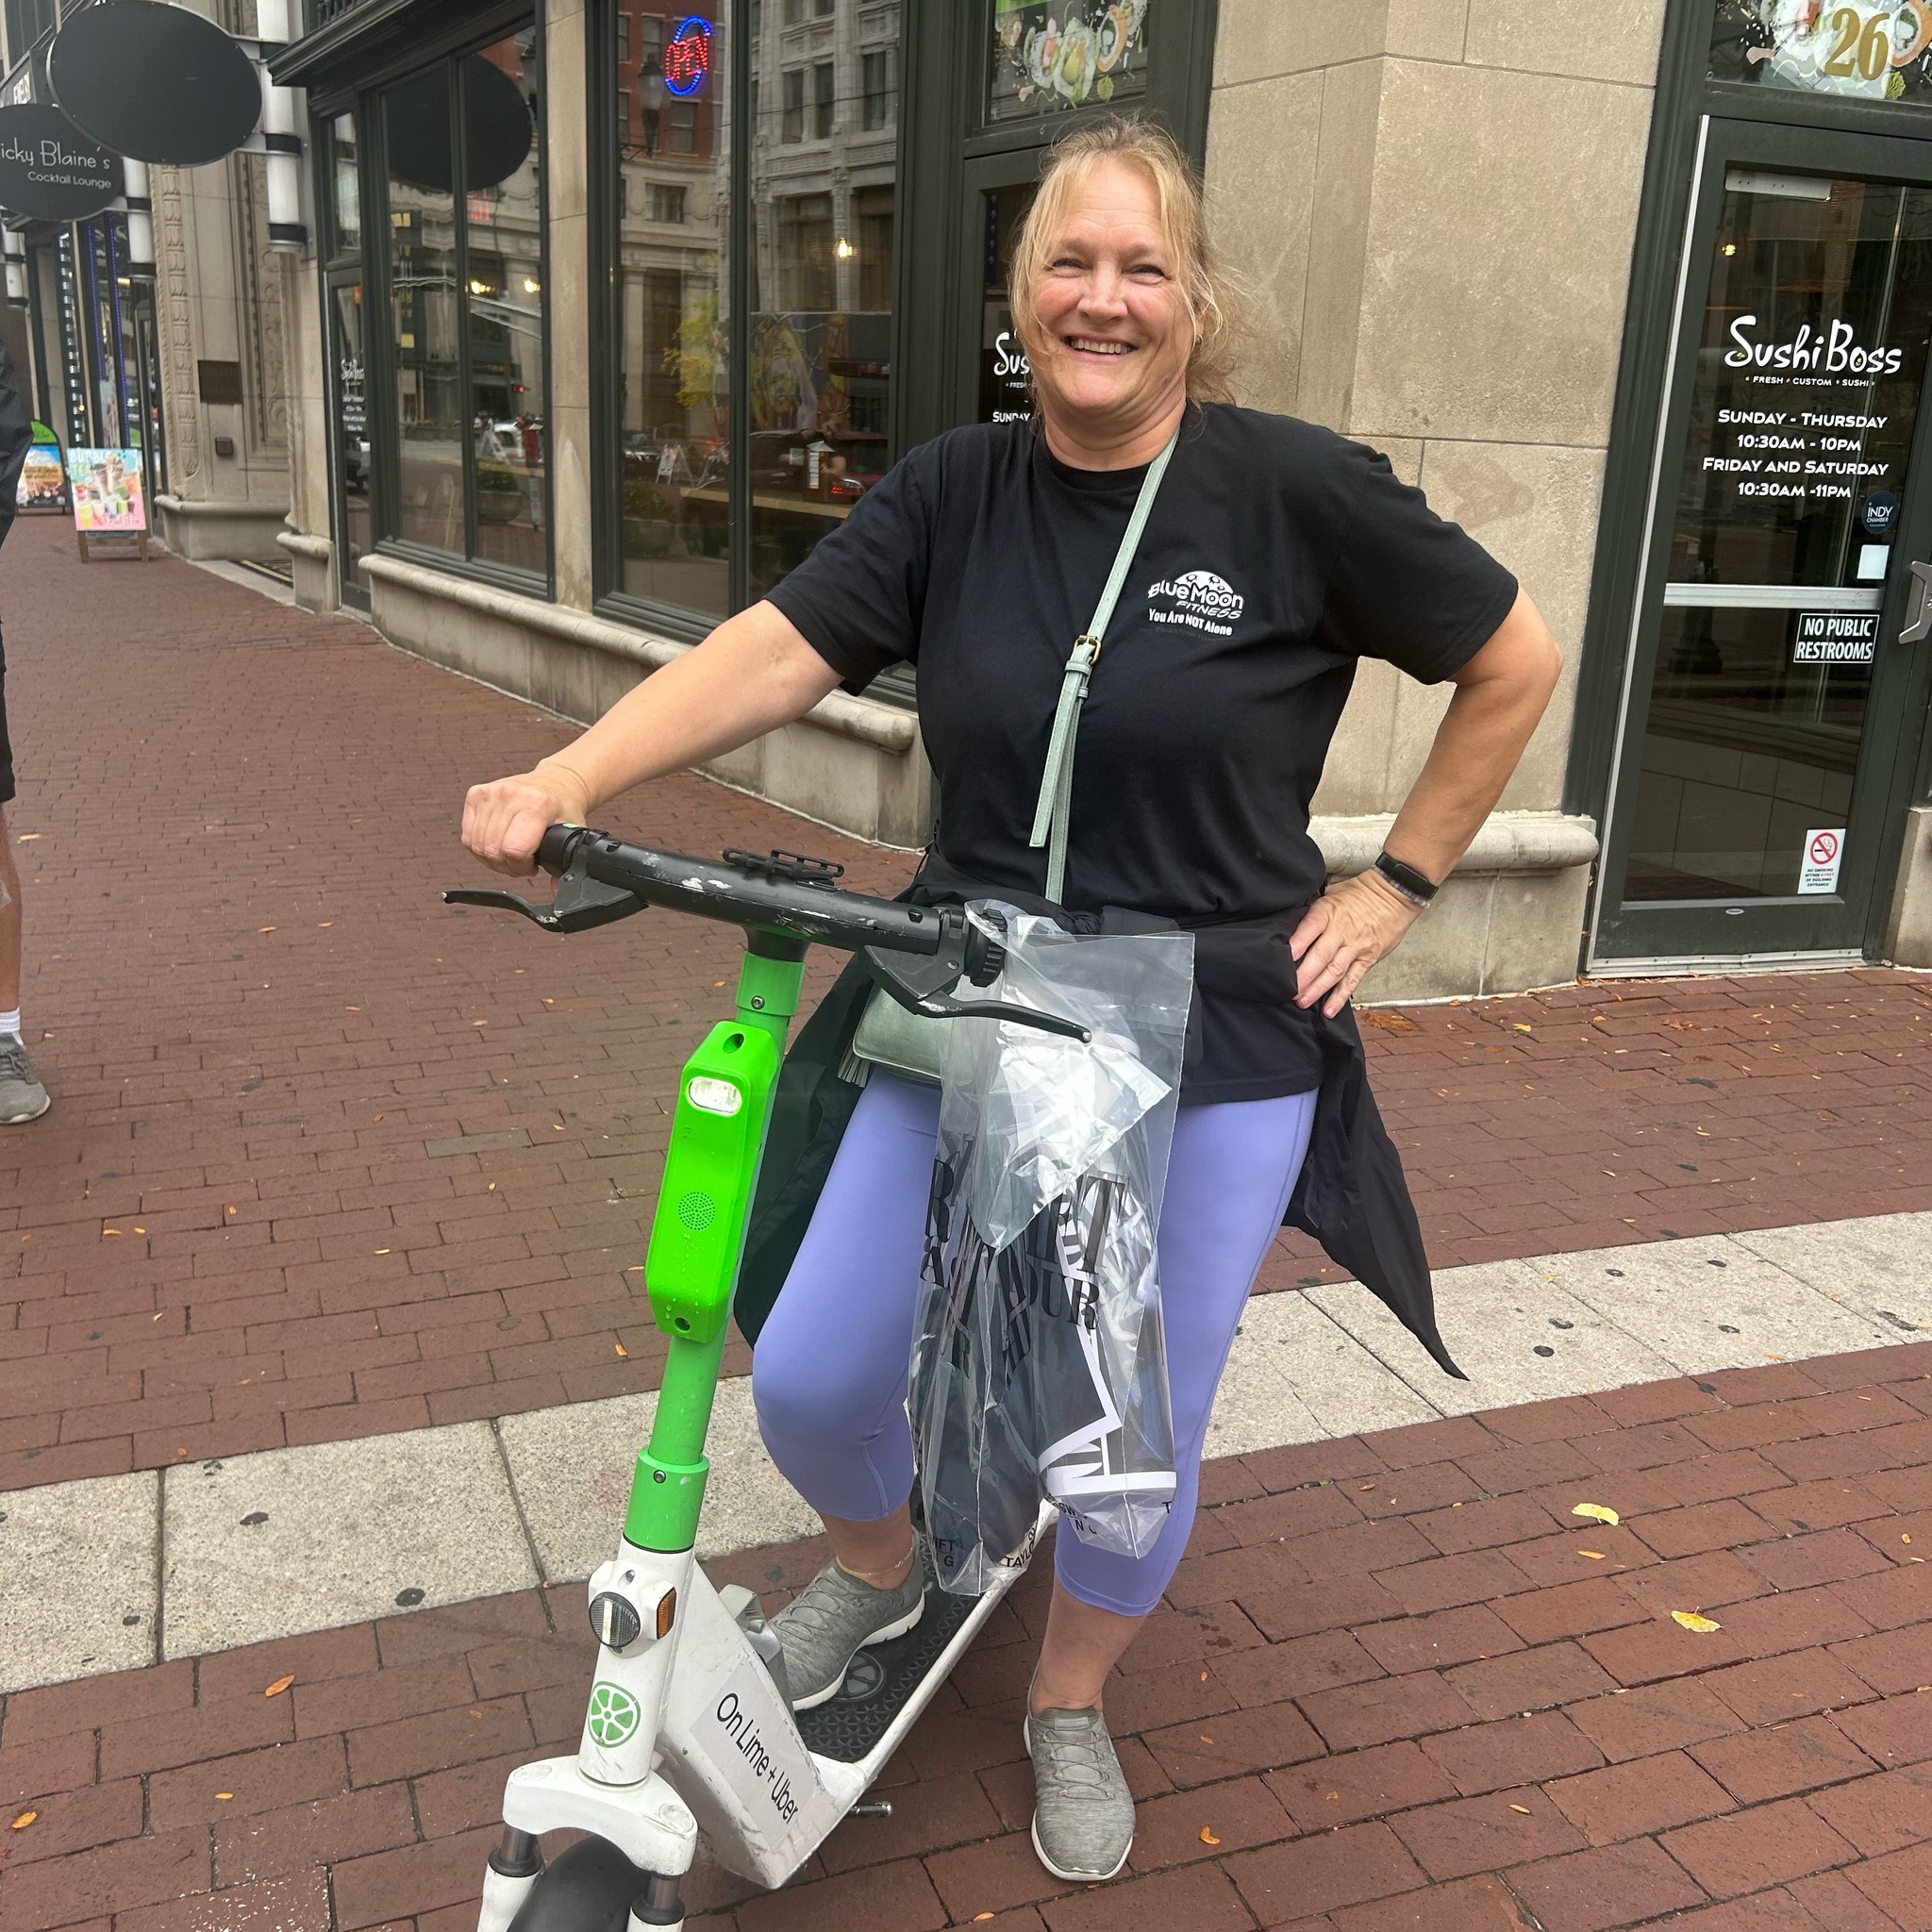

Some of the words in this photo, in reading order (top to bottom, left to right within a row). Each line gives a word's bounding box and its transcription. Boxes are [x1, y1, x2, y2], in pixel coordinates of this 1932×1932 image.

[1824, 8, 1890, 80] 26
[665, 33, 708, 80] OPEN
[0, 137, 34, 166] icky
[27, 171, 71, 184] Cocktail
[73, 175, 111, 190] Lounge
[1753, 375, 1784, 384] FRESH
[1792, 377, 1832, 387] CUSTOM
[1841, 378, 1870, 388] SUSHI
[1718, 409, 1787, 425] SUNDAY
[1801, 412, 1888, 428] THURSDAY
[1737, 435, 1806, 450] 10:30AM
[1820, 438, 1861, 452] 10PM
[1703, 458, 1762, 473] FRIDAY
[1764, 461, 1801, 473] AND
[1805, 460, 1890, 475] SATURDAY
[1738, 482, 1806, 497] 10:30AM
[1175, 600, 1242, 620] FITNESS
[1148, 608, 1166, 623] You
[1167, 610, 1185, 624] Are
[1185, 613, 1205, 629] NOT
[1204, 620, 1233, 636] Alone
[1804, 618, 1824, 636] NO
[1826, 619, 1873, 636] PUBLIC
[1796, 641, 1873, 659] RESTROOMS
[717, 1692, 743, 1737] On
[736, 1719, 770, 1777] Lime
[771, 1771, 799, 1824] Uber
